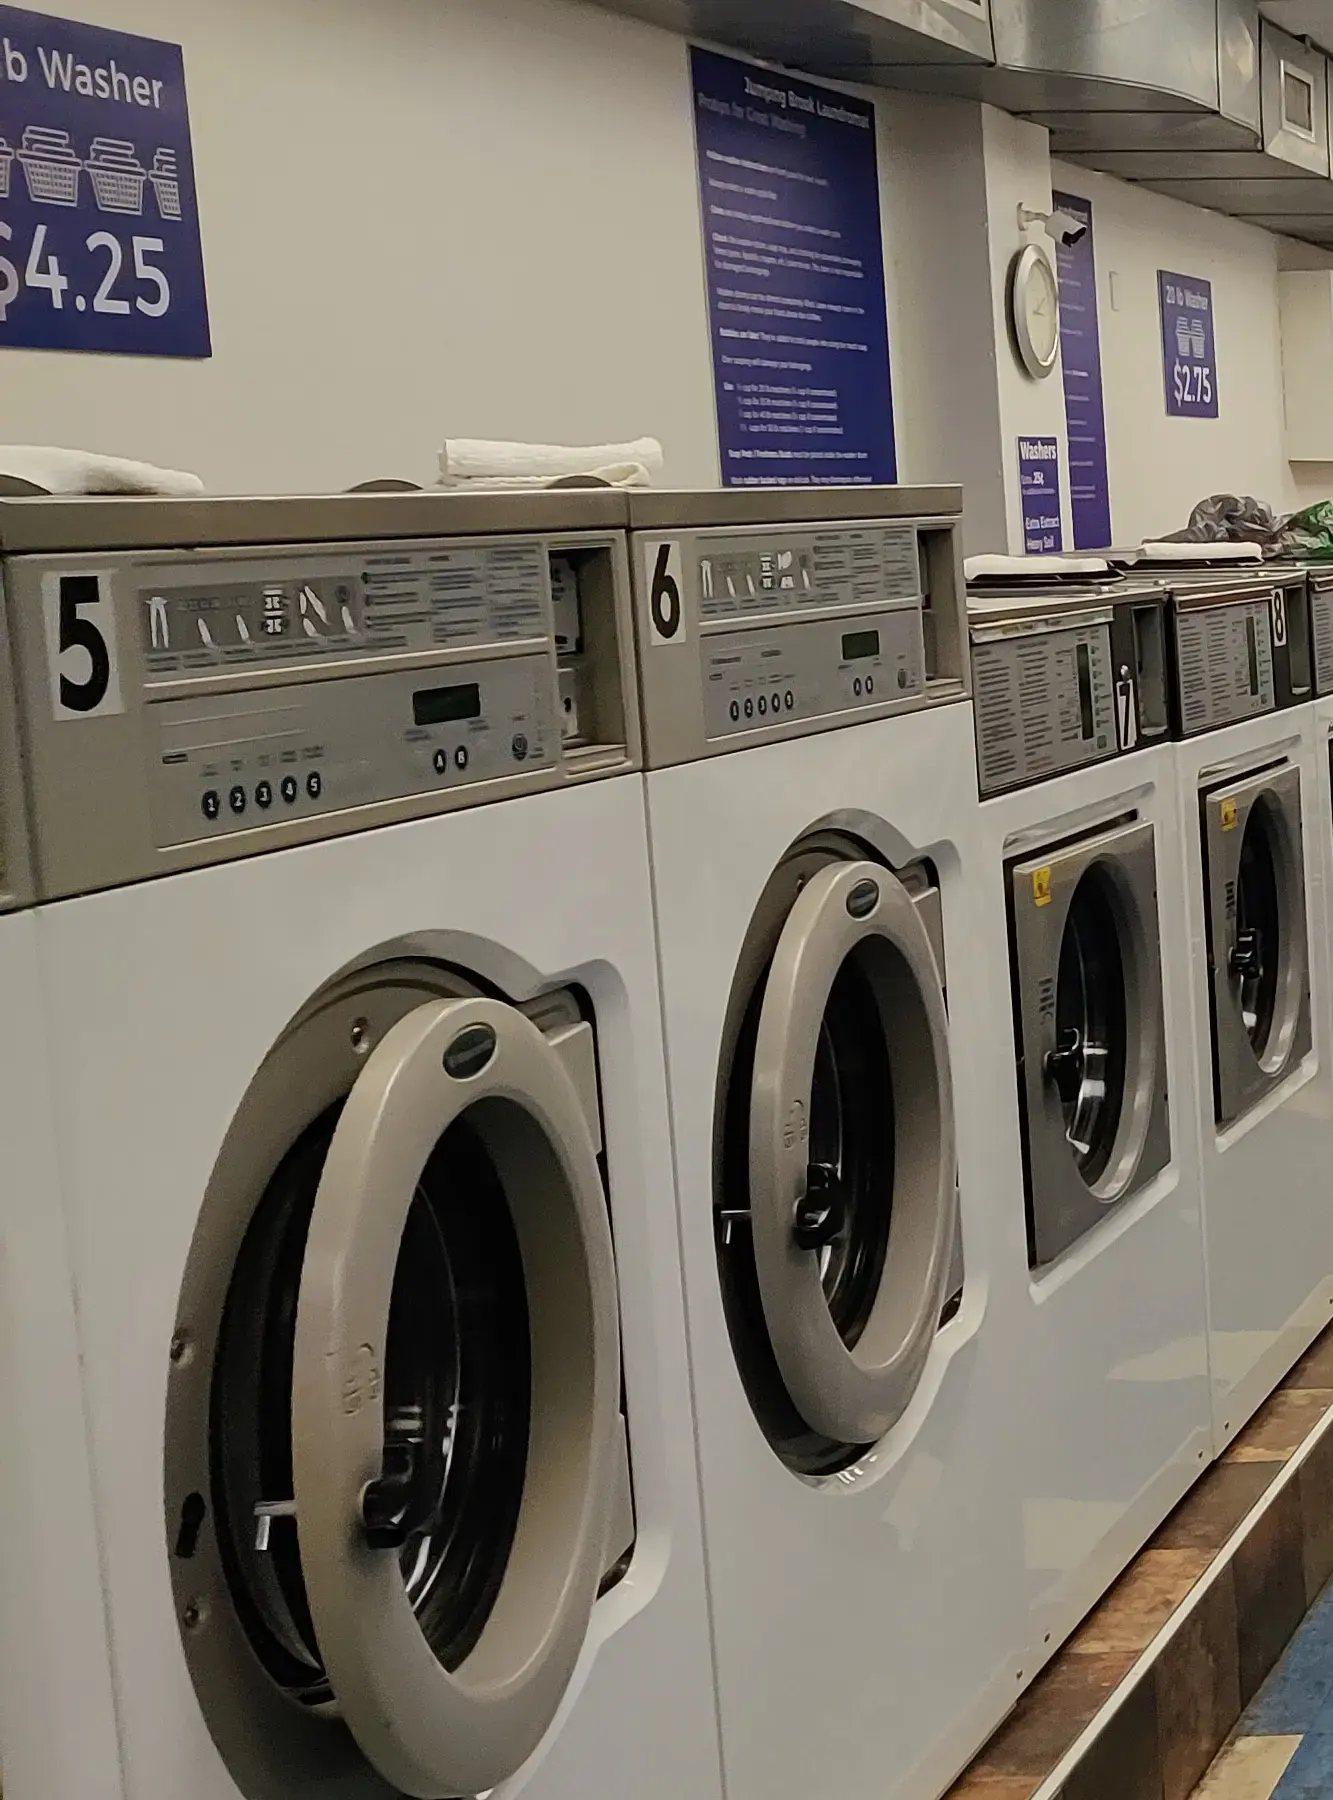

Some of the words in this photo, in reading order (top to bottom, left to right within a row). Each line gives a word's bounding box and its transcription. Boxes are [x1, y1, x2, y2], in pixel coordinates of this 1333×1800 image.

[37, 46, 164, 109] Washer
[1173, 358, 1212, 408] $2.75
[1019, 440, 1057, 460] Washers
[651, 544, 680, 639] 6
[1274, 592, 1284, 642] 8
[59, 576, 110, 712] 5
[1119, 683, 1131, 748] 7
